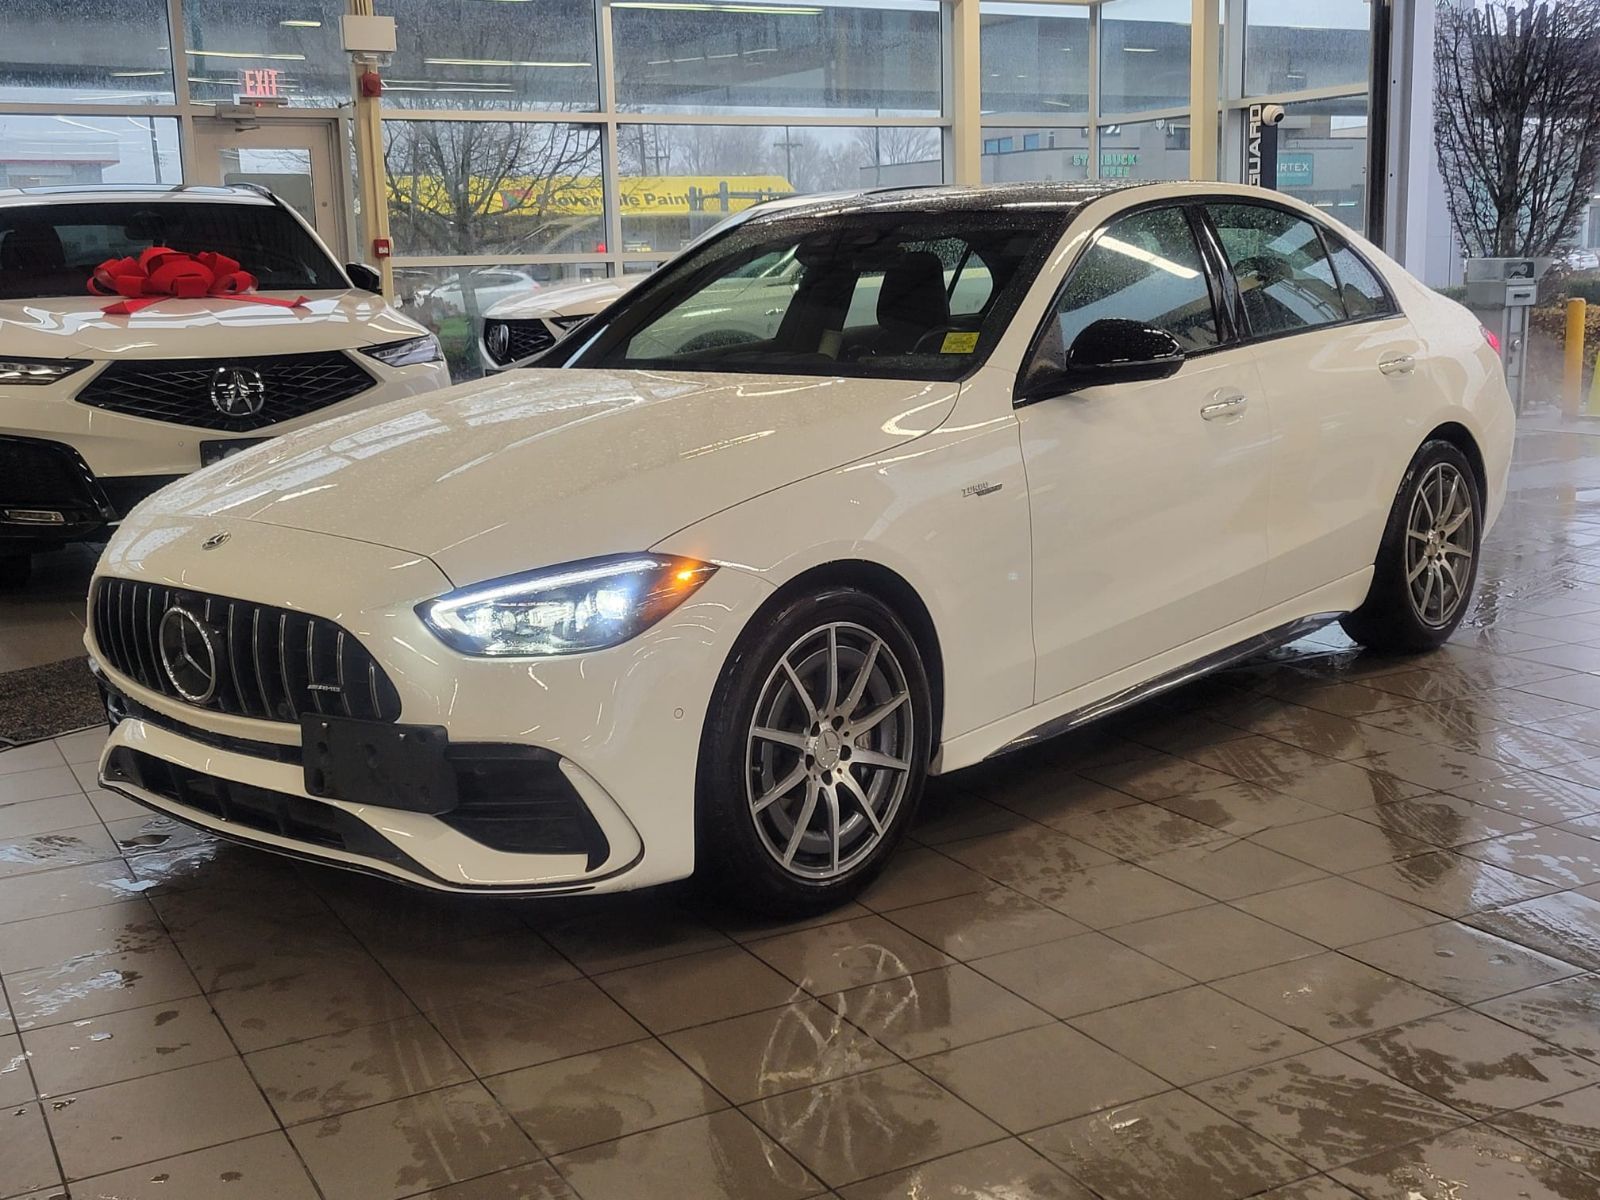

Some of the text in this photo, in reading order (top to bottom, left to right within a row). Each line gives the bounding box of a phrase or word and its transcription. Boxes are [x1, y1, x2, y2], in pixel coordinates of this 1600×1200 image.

[245, 69, 278, 96] EXIT
[1073, 153, 1143, 166] STBUCK
[1277, 162, 1310, 172] RTEX
